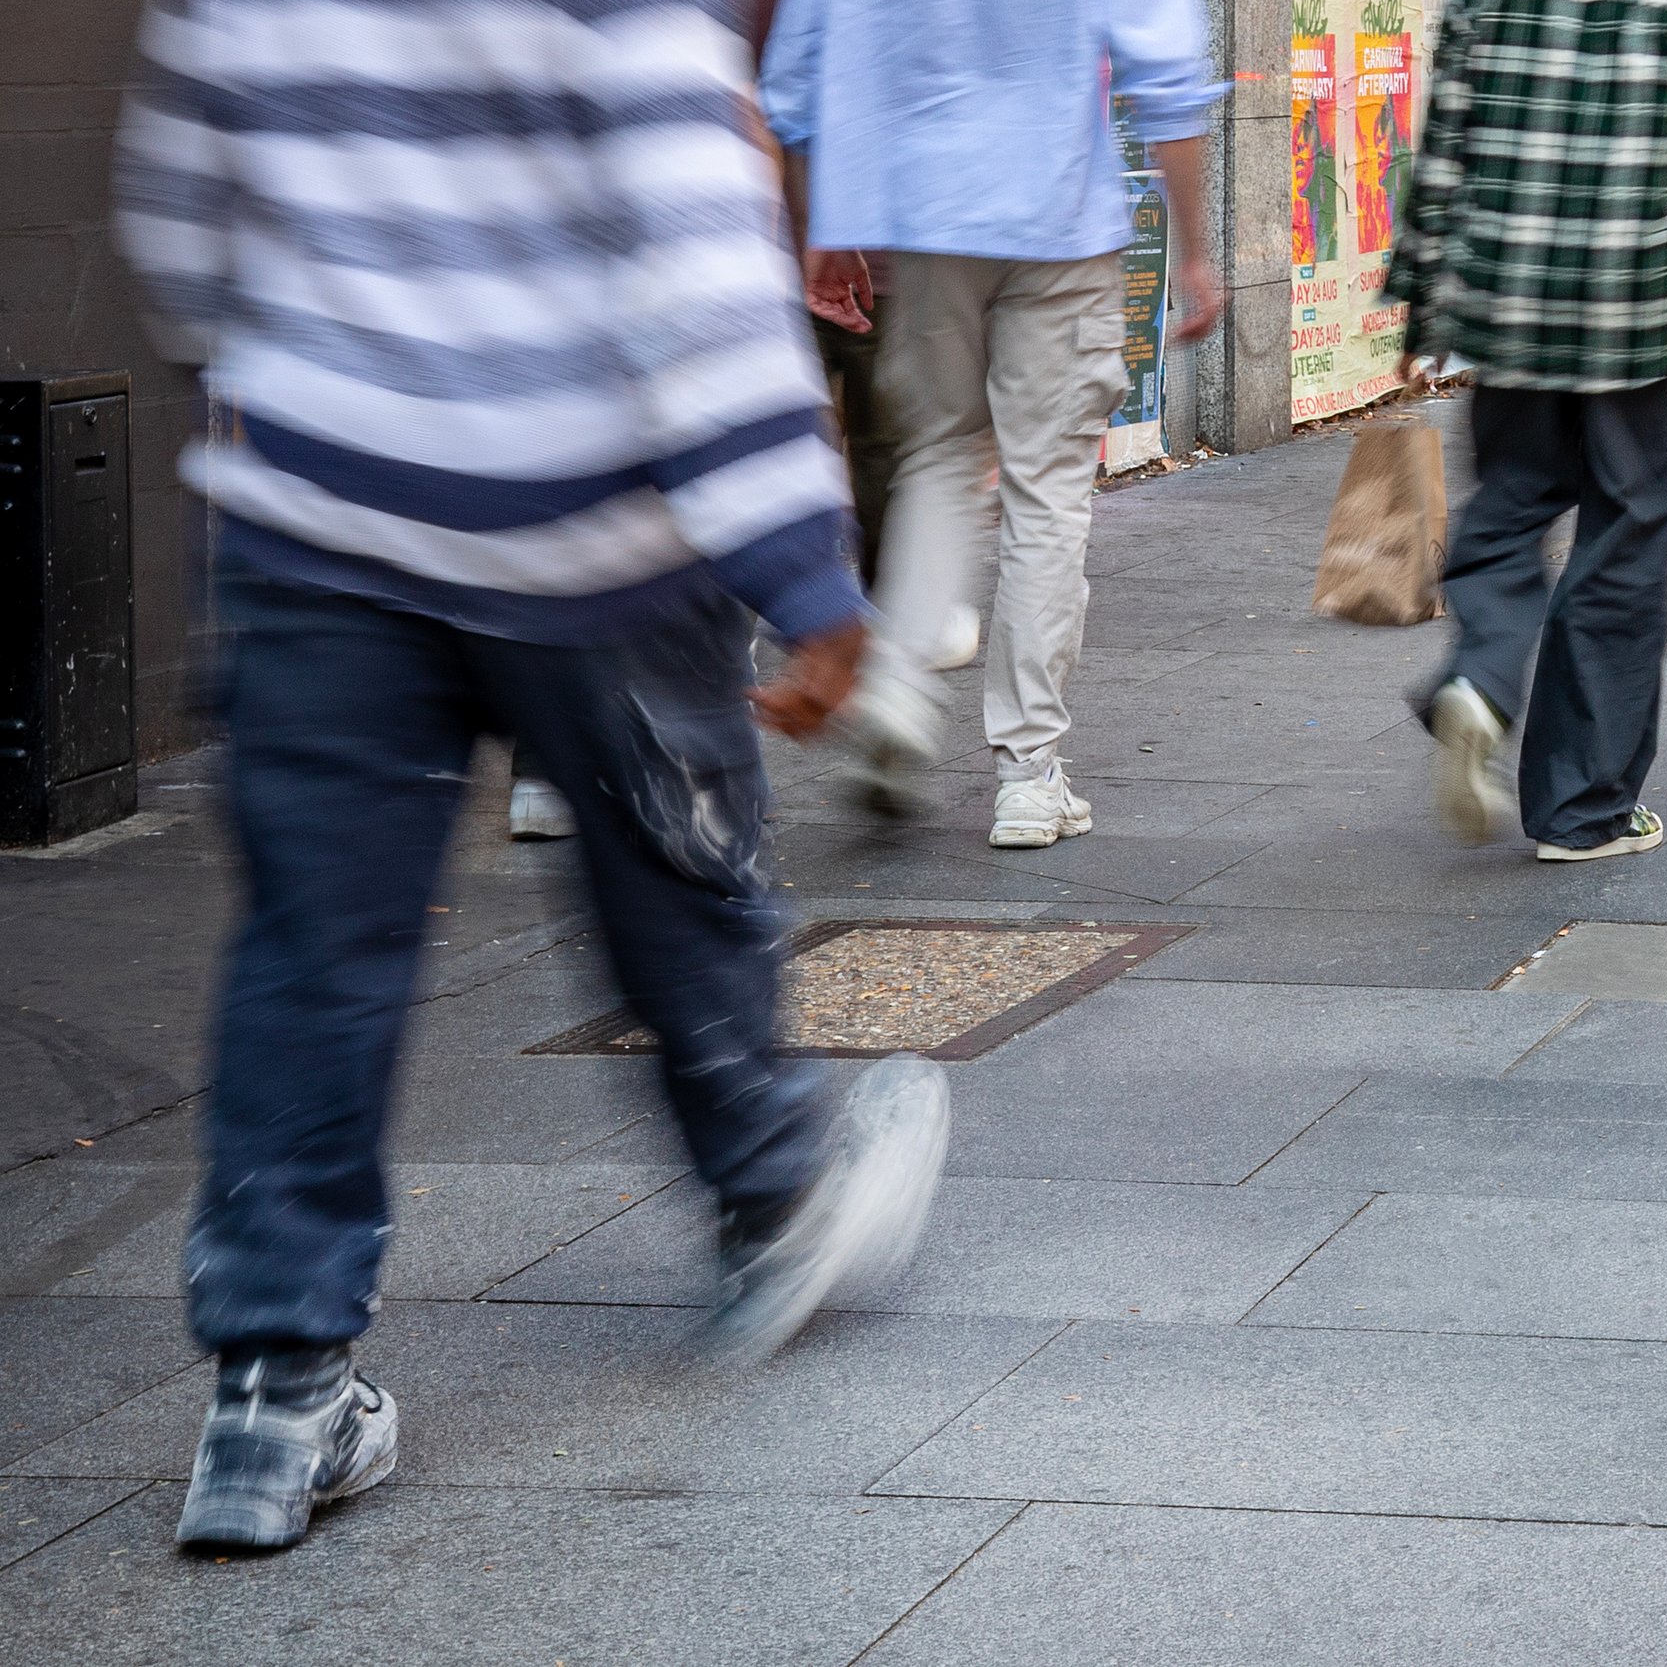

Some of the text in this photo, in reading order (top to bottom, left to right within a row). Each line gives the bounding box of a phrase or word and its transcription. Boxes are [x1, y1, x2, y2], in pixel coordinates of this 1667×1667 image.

[1363, 46, 1403, 70] CARNIVAL
[1292, 77, 1333, 101] TERPARTY
[1358, 73, 1409, 97] AFTERPARTY
[1322, 280, 1338, 302] AUG
[1326, 323, 1341, 345] AUG
[1291, 352, 1334, 378] UTERNET
